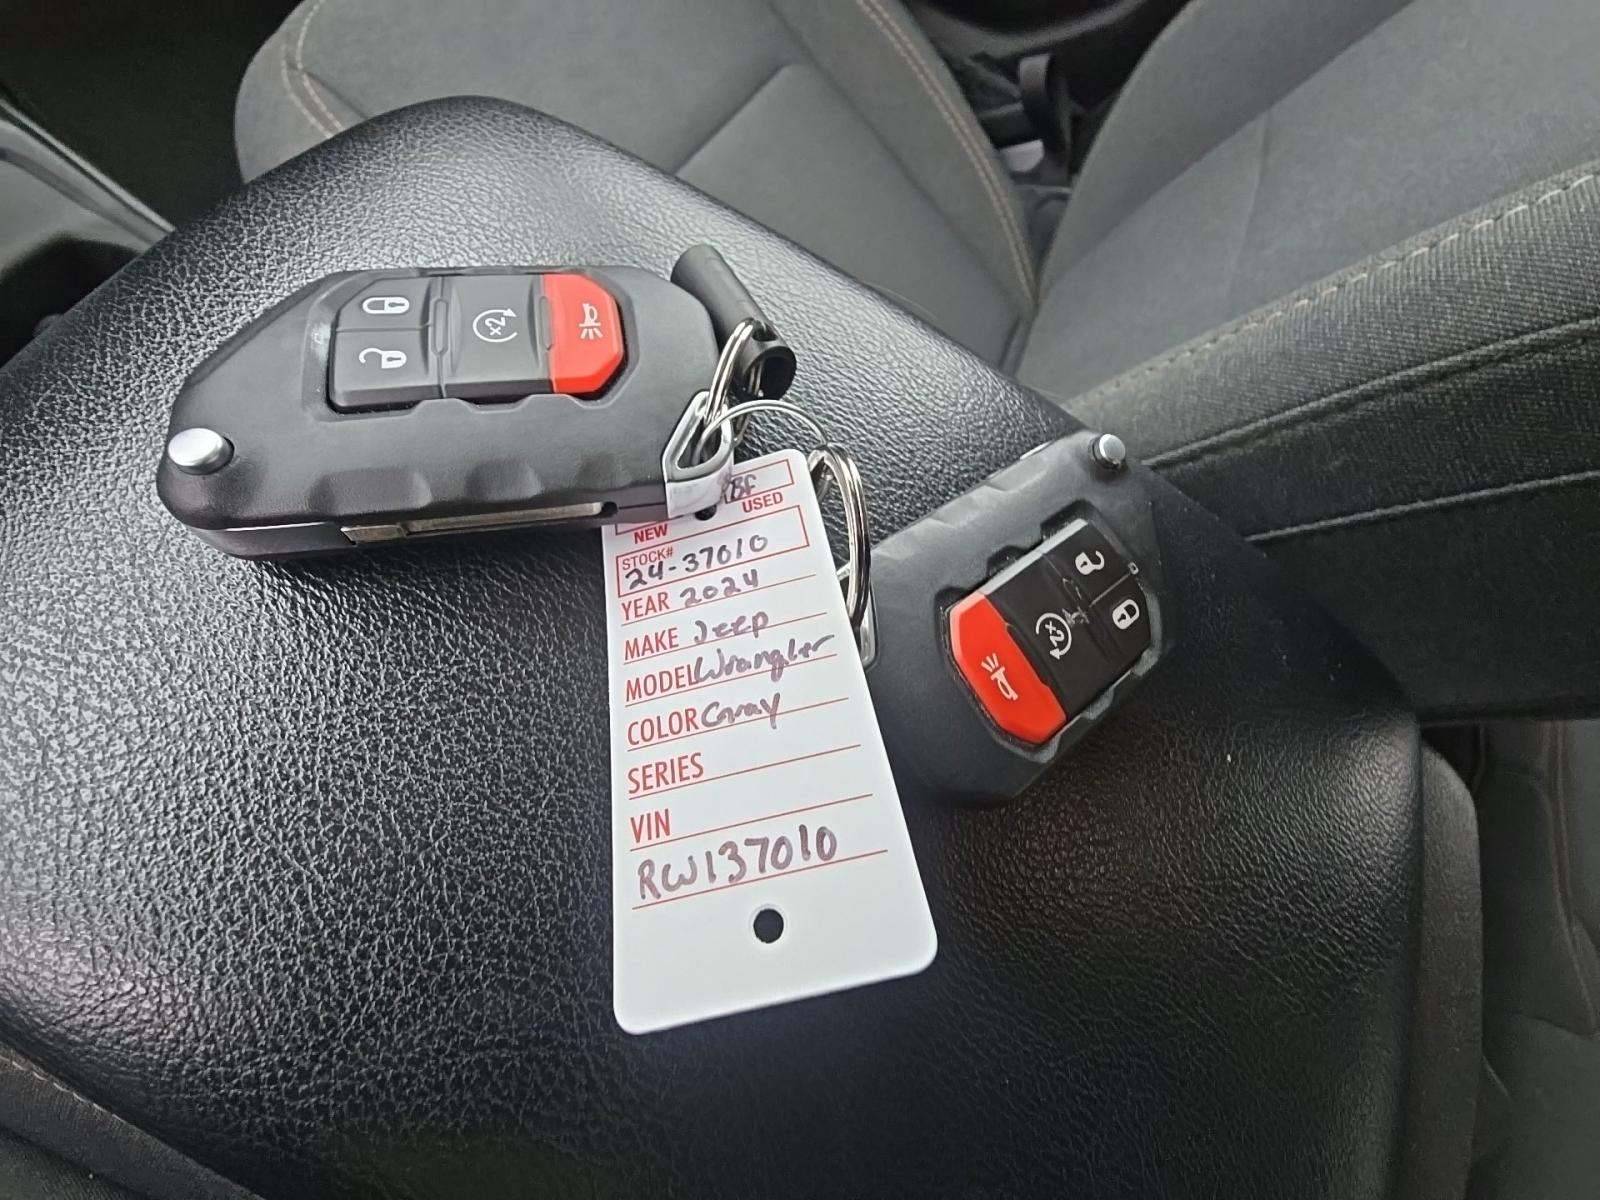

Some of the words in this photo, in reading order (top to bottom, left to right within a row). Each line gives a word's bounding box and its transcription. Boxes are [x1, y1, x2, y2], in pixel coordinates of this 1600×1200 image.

[742, 491, 784, 513] USED
[622, 547, 674, 571] STOCK#
[633, 524, 669, 544] NEW
[625, 535, 769, 590] 24-37010
[621, 592, 670, 621] YEAR
[680, 569, 759, 608] 2024
[624, 627, 679, 661] MAKE
[693, 611, 769, 644] Jeep
[626, 664, 699, 702] MODEL
[693, 634, 835, 682] Wrangler
[627, 707, 700, 746] COLOR
[701, 692, 781, 730] Gray
[627, 752, 704, 794] SERIES
[630, 808, 671, 843] VIN
[637, 824, 838, 900] RW137010
